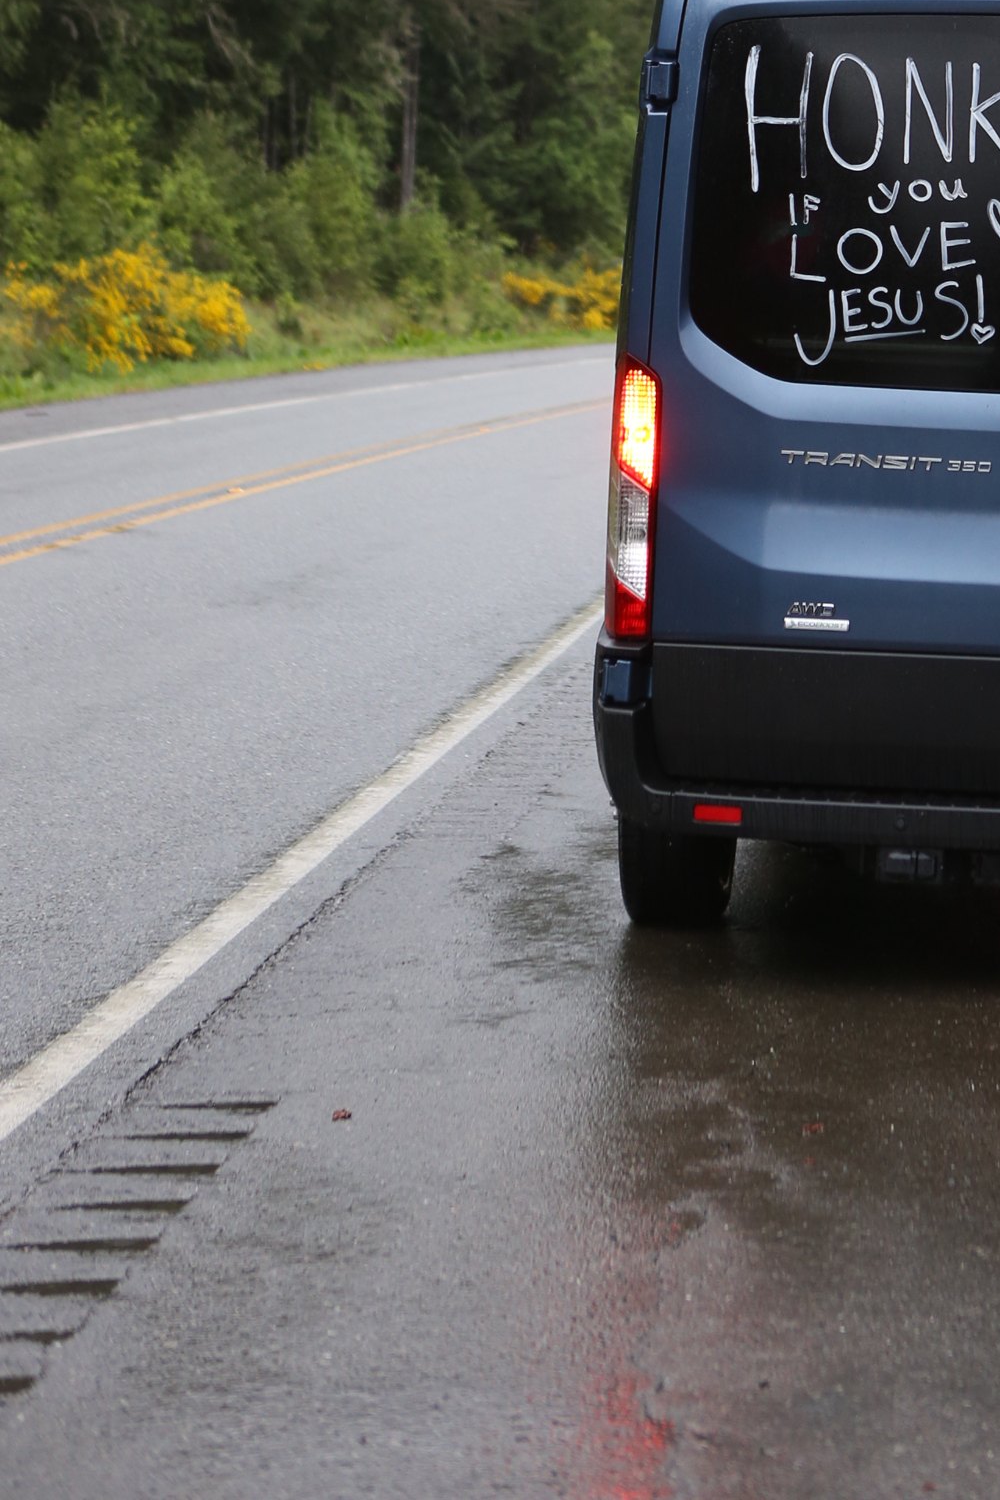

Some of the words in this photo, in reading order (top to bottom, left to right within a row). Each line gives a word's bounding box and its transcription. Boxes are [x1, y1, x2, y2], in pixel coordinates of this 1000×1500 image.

[788, 193, 821, 226] IF
[867, 178, 968, 214] you
[789, 221, 976, 283] LOVE
[793, 274, 995, 366] JESUS!
[780, 449, 943, 471] TRANSIT
[947, 459, 992, 473] 350
